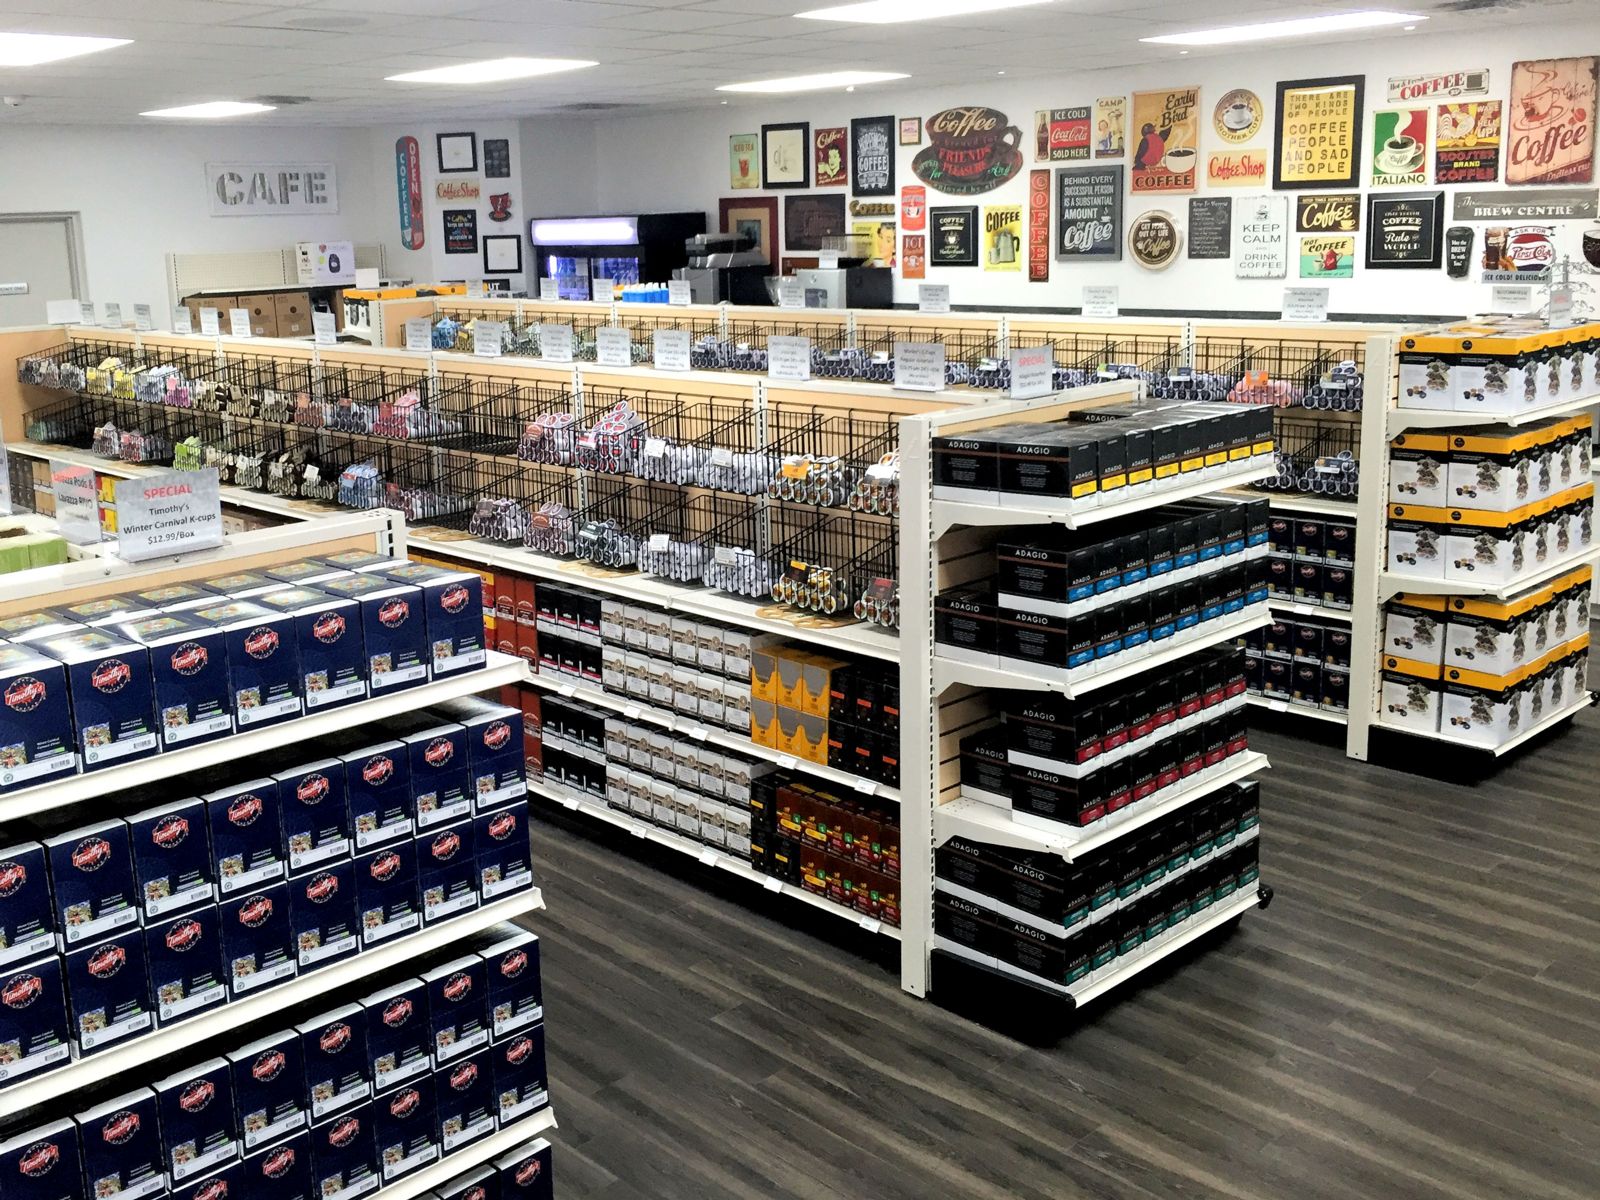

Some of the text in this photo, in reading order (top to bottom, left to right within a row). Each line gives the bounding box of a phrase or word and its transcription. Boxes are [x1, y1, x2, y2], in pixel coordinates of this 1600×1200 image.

[1400, 73, 1465, 100] COFFEE
[1166, 90, 1196, 111] Early
[1054, 110, 1086, 120] ICE COLD
[1160, 108, 1188, 128] Bird
[1308, 110, 1347, 118] PEOPLE
[933, 108, 997, 137] Coffee
[1217, 119, 1248, 140] ANOTHER
[1289, 122, 1347, 135] COFFEE
[1289, 135, 1346, 148] PEOPLE
[1512, 124, 1587, 166] Coffee
[1053, 148, 1088, 158] SOLD HERE
[1285, 149, 1348, 162] AND SAD
[1438, 151, 1496, 161] ROOSTER
[409, 143, 418, 194] OPEN
[860, 156, 886, 171] COFFEE
[1210, 155, 1264, 180] Coffee Shop
[1288, 162, 1345, 174] PEOPLE
[1064, 176, 1114, 186] BEHIND EVERY
[1135, 175, 1192, 188] COFFEE
[1372, 174, 1426, 186] ITALIANO
[1437, 168, 1494, 181] COFFEE
[216, 171, 328, 205] CAFE
[400, 153, 409, 226] COFFEE
[1064, 185, 1114, 196] SUCCESSFUL PERSON
[1076, 196, 1112, 206] SUBSTANTIAL
[1458, 197, 1476, 208] The
[1064, 208, 1098, 220] AMOUNT
[1302, 203, 1353, 229] Coffee
[1474, 206, 1574, 216] BREW CENTRE
[986, 212, 1020, 232] COFFEE
[1032, 174, 1048, 278] COFFEE
[1243, 224, 1280, 232] KEEP
[1382, 216, 1422, 226] COFFEE
[1064, 220, 1112, 252] Coffee
[1242, 235, 1281, 243] CALM
[1142, 239, 1171, 256] Coffee
[1308, 241, 1348, 252] COFFEE
[948, 442, 980, 450] ADAGIO
[1016, 446, 1050, 455] ADAGIO
[144, 484, 193, 500] SPECIAL
[149, 504, 190, 516] Timothy's
[123, 514, 216, 534] Winter Carnival K-cups
[148, 531, 195, 545] $12.99/Box
[1016, 550, 1048, 560] ADAGIO
[950, 601, 980, 612] ADAGIO
[1016, 614, 1048, 625] ADAGIO
[246, 632, 280, 652] Timothy's
[174, 648, 208, 669] Timothy's
[94, 665, 130, 686] Timothy's
[6, 682, 45, 704] Timothy's
[1023, 710, 1056, 722] ADAGIO
[976, 746, 1005, 760] ADAGIO
[1027, 770, 1059, 784] ADAGIO
[74, 844, 110, 864] Timothy's
[950, 840, 980, 857] ADAGIO
[1013, 864, 1045, 881] ADAGIO
[950, 899, 980, 916] ADAGIO
[1014, 924, 1046, 942] ADAGIO
[2, 978, 42, 1000] Timothy's
